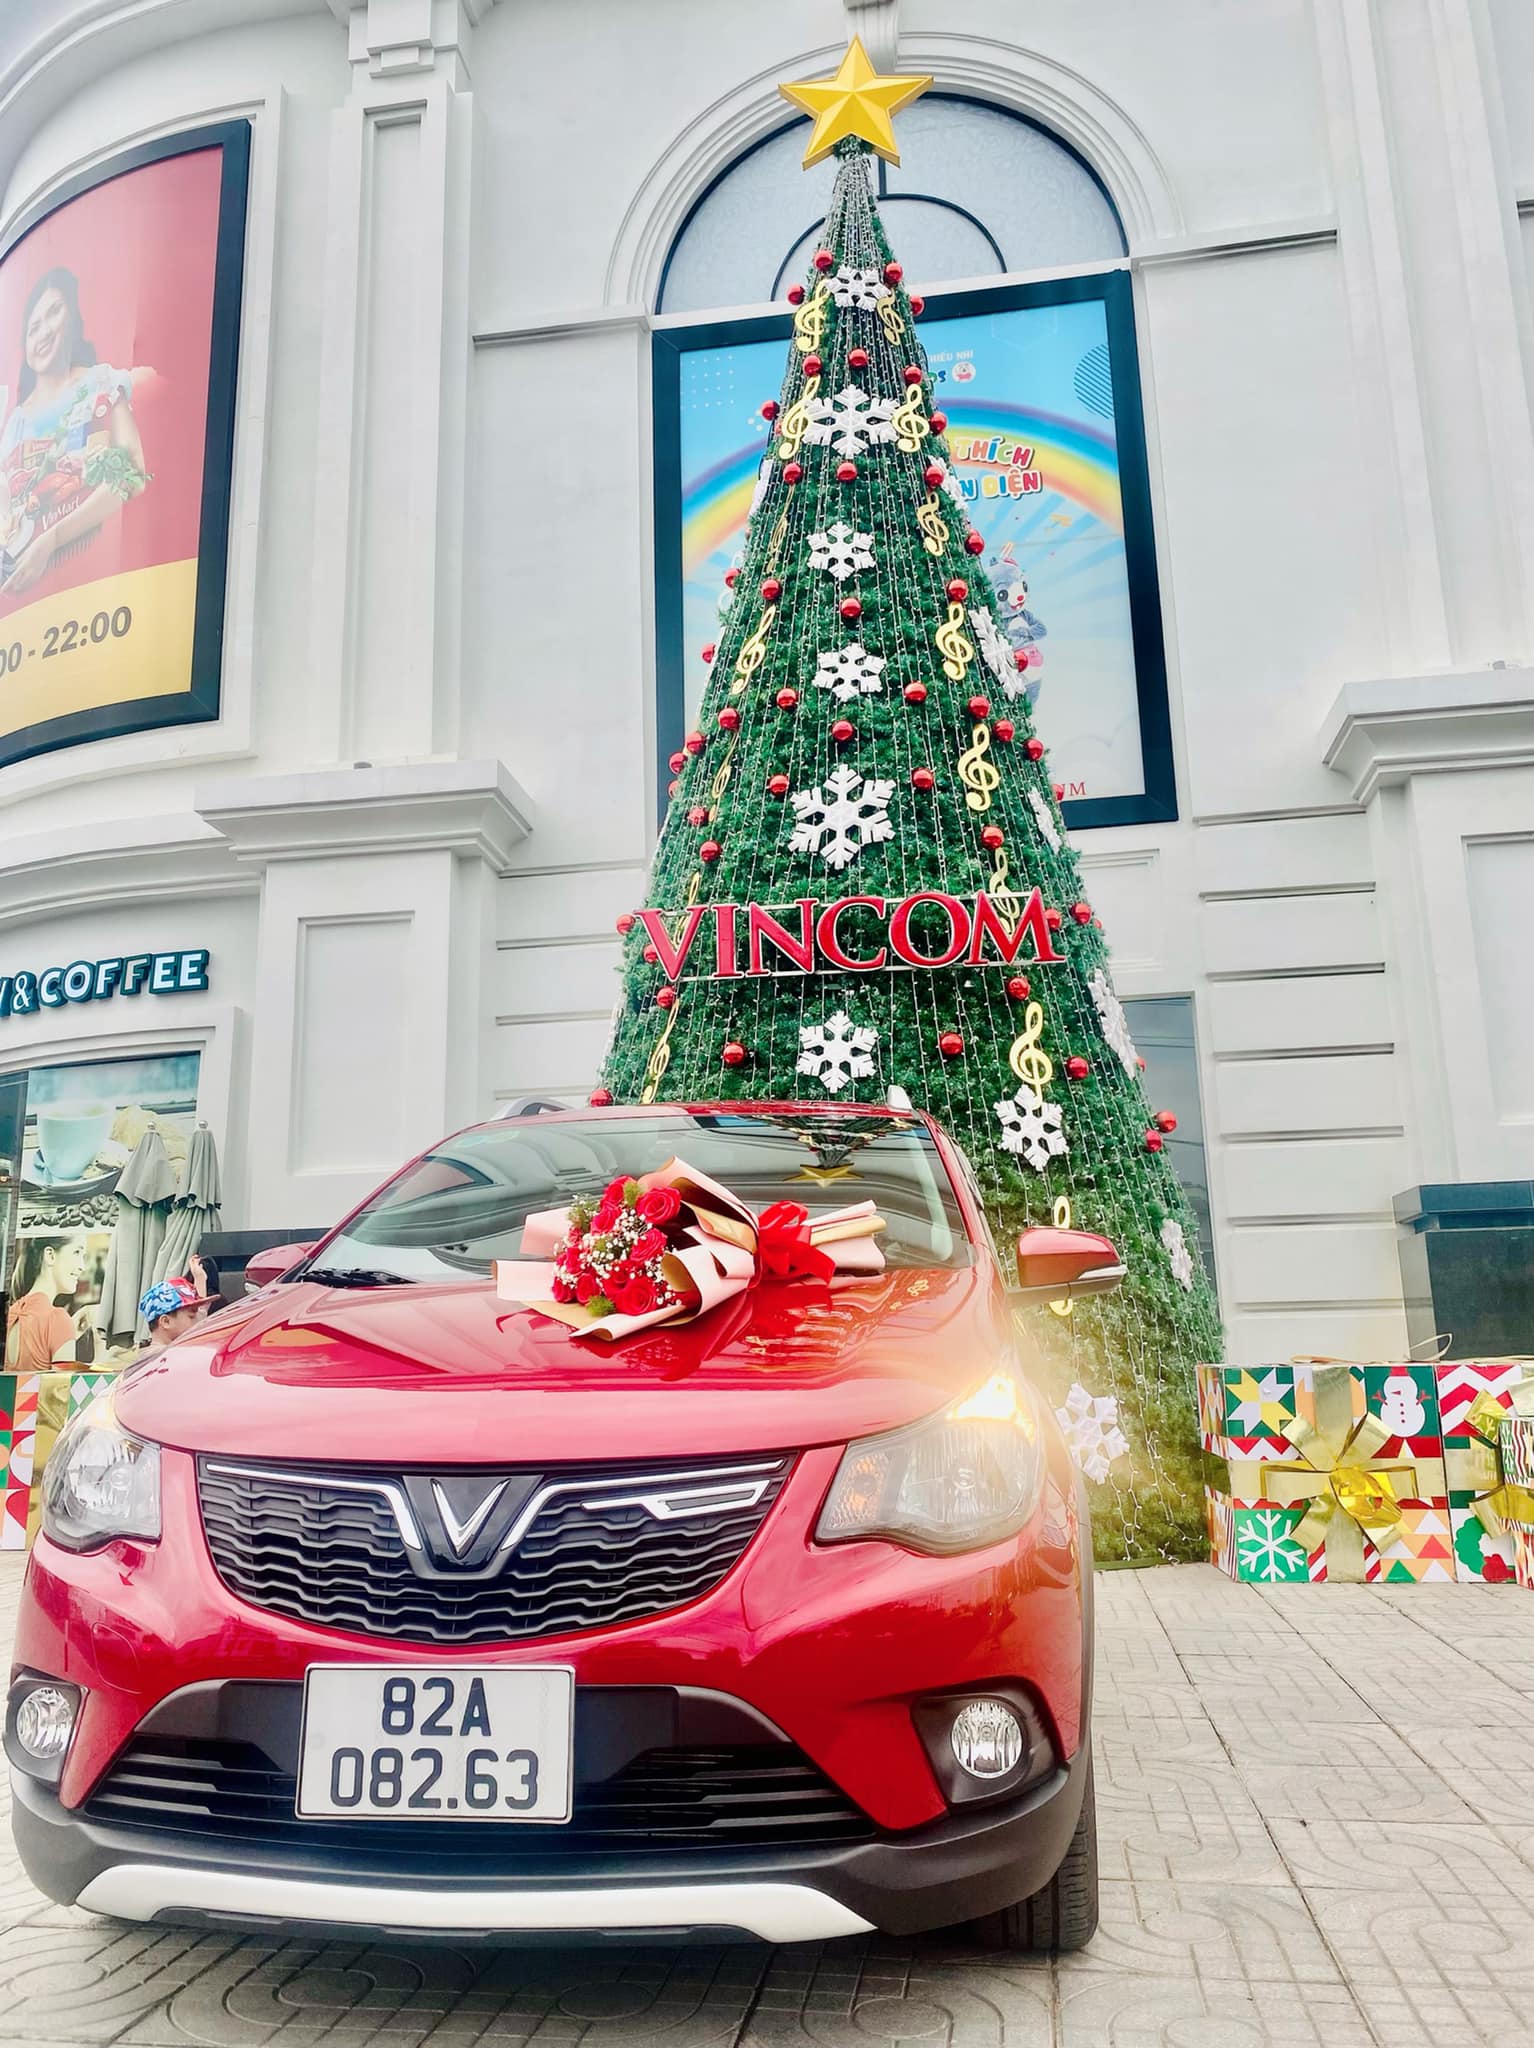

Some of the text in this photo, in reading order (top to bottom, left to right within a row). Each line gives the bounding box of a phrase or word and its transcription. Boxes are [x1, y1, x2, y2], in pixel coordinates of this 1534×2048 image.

[955, 437, 1033, 468] THÍCH
[42, 606, 132, 659] 22:00
[633, 886, 1066, 981] VINCOM
[381, 1676, 492, 1737] 82A
[330, 1746, 539, 1810] 082.63
